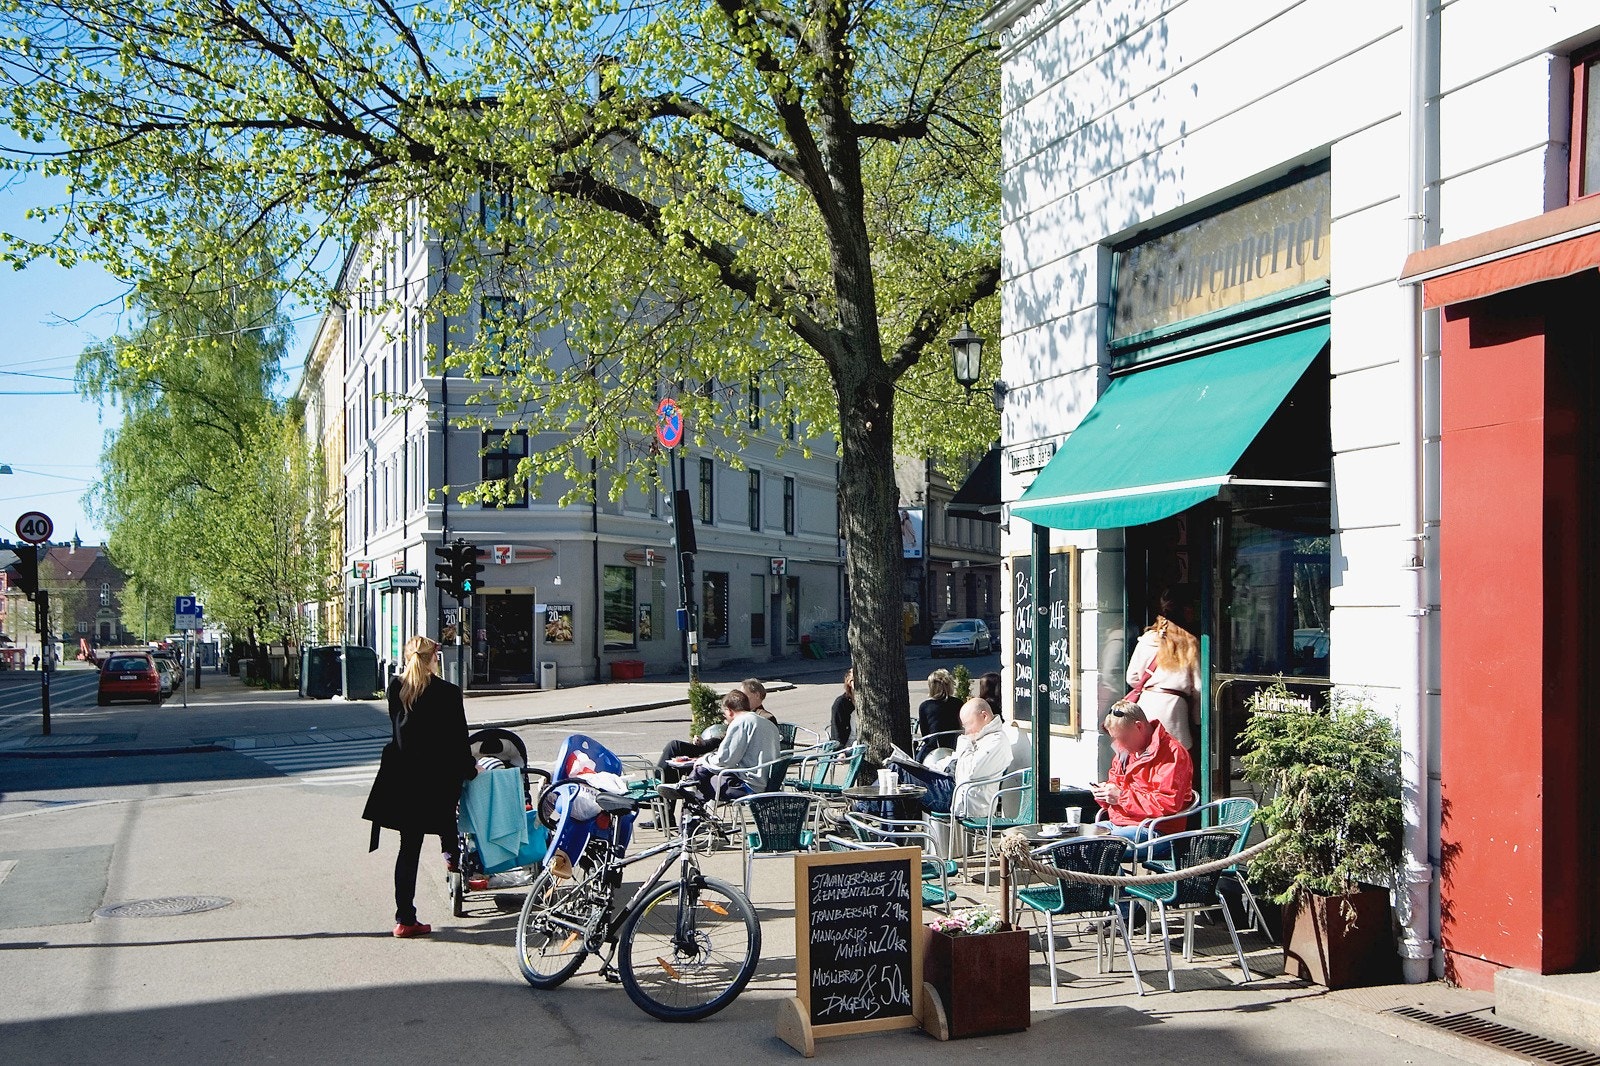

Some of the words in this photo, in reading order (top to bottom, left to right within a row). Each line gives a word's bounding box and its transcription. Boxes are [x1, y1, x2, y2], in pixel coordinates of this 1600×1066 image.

[22, 519, 48, 536] 40
[180, 598, 191, 613] P
[817, 992, 881, 1019] DAGENS
